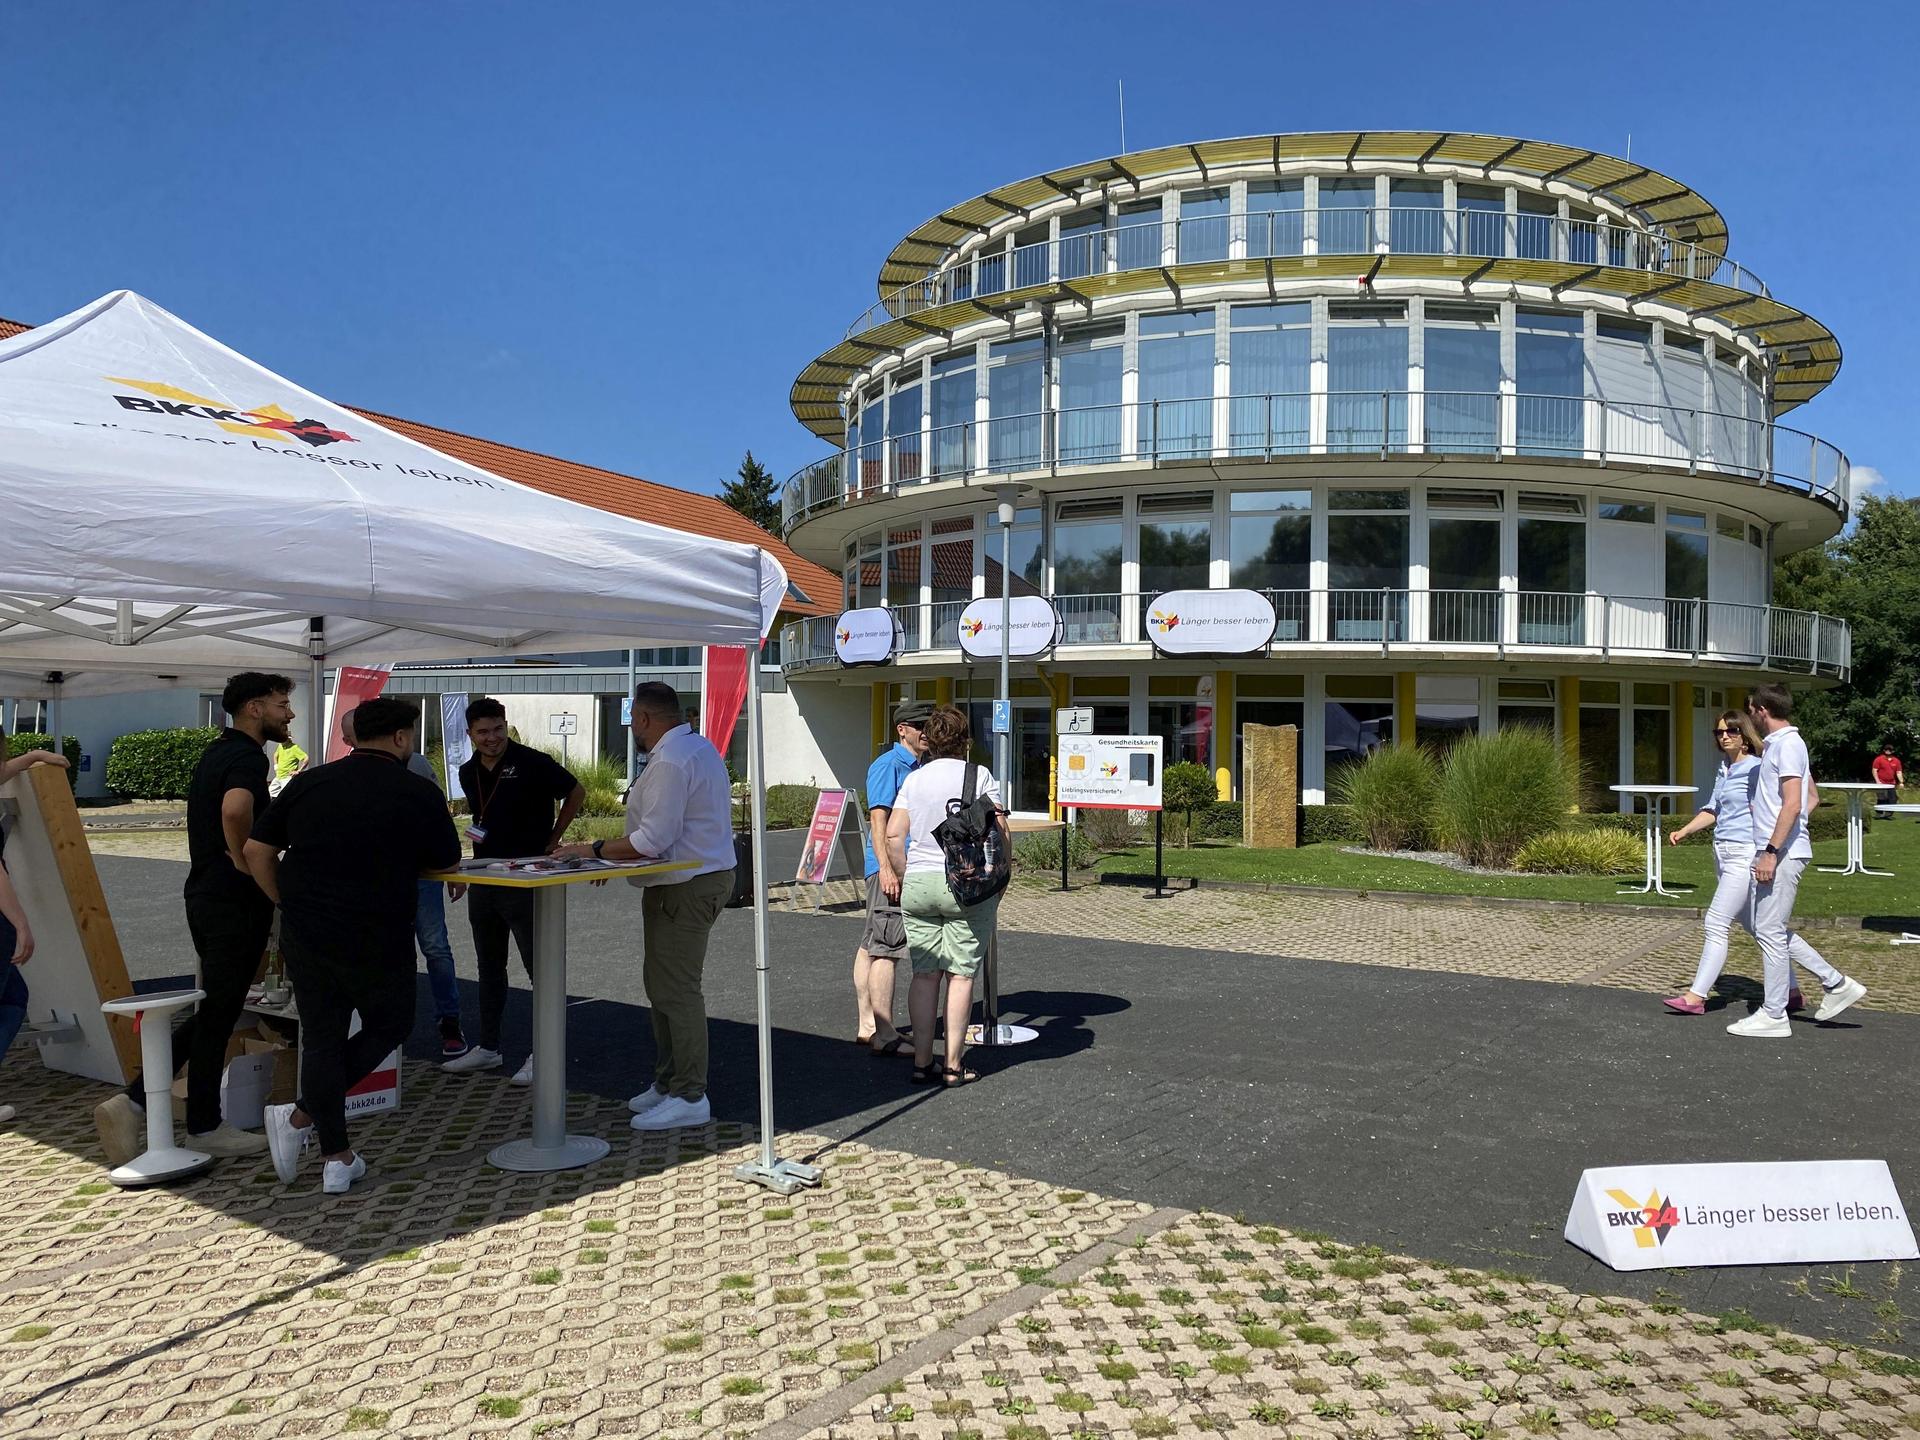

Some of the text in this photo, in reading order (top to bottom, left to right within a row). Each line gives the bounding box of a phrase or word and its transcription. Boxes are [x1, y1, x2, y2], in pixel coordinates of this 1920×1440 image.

[395, 463, 505, 491] leben.
[984, 623, 1003, 631] Länge
[1181, 616, 1210, 627] Länger
[1213, 616, 1242, 625] besser
[996, 703, 1003, 715] P
[1098, 738, 1159, 746] Gesundheitskarte
[1607, 1201, 1901, 1229] BKK24 Länger besser leben.
